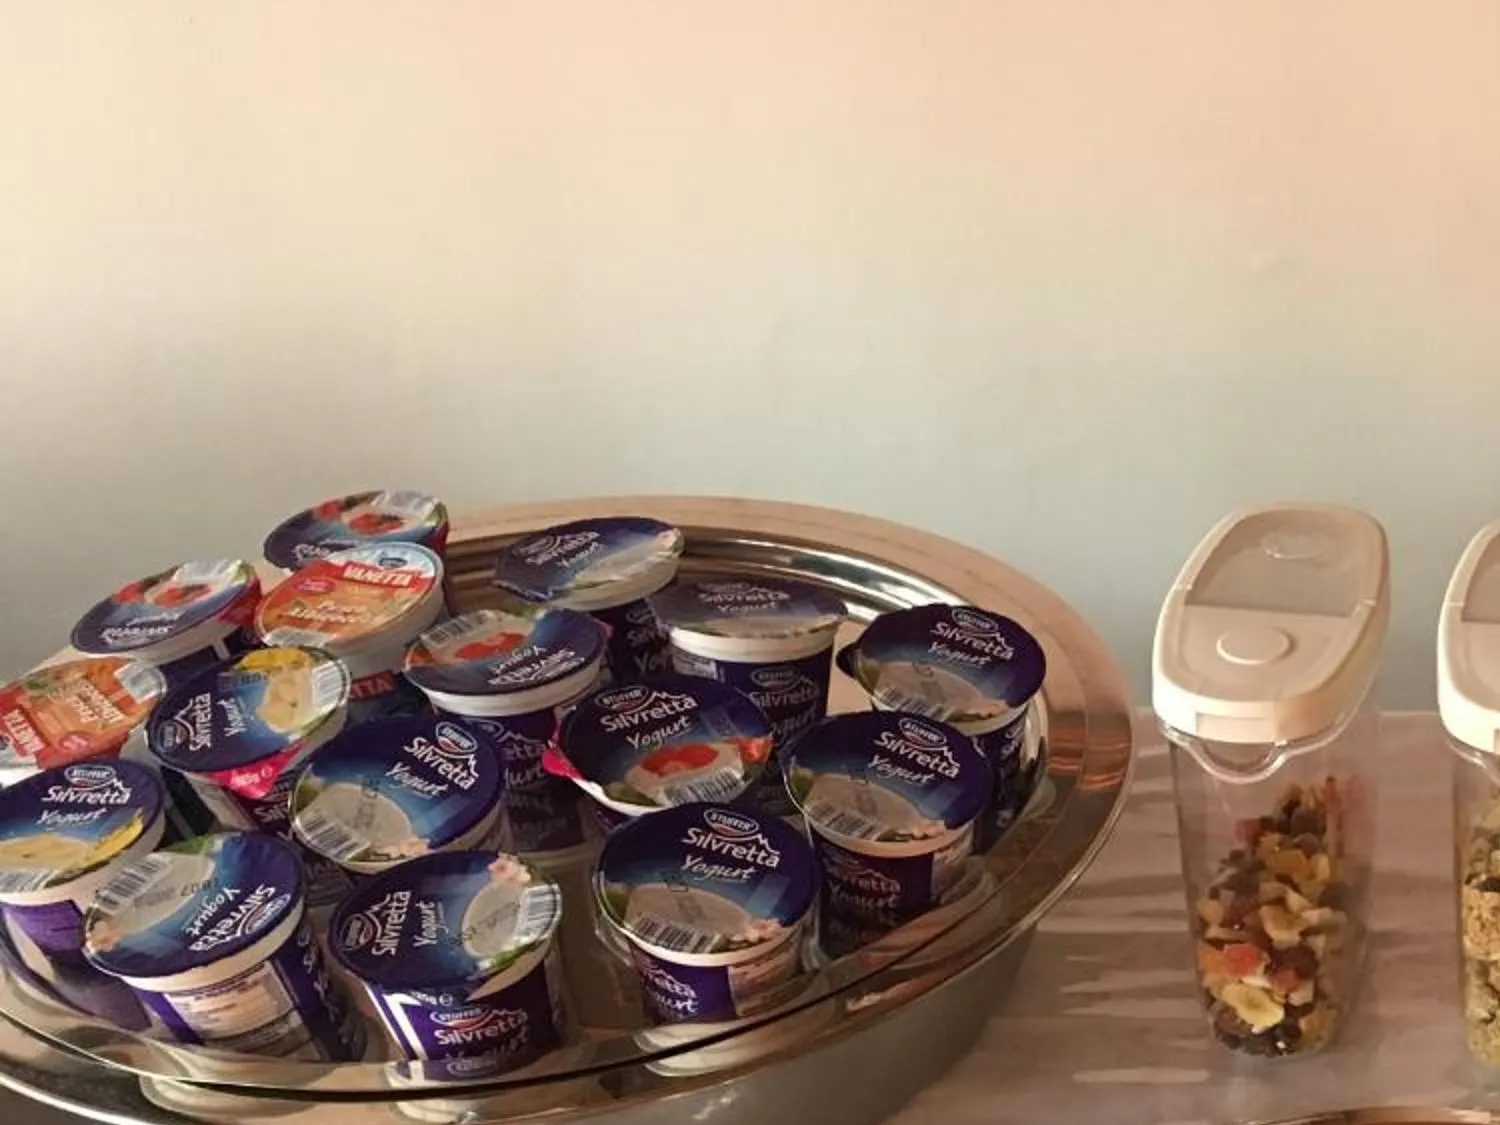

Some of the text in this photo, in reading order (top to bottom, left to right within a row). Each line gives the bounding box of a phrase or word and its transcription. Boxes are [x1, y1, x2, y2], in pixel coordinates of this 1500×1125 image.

[343, 564, 413, 587] VANETTA
[930, 621, 1014, 661] Silvretta
[189, 692, 212, 751] Silvretta
[600, 695, 698, 732] Silvretta
[626, 715, 692, 749] Yogurt
[404, 736, 476, 790] Silvretta
[867, 754, 936, 784] Yogurt
[873, 731, 961, 779] Silvretta
[40, 785, 132, 805] Silvretta
[385, 762, 449, 797] Yogurt
[680, 854, 754, 881] Yogurt
[681, 827, 781, 869] Silvretta
[184, 886, 241, 938] Yogurt
[188, 884, 276, 951] Silvretta
[372, 890, 411, 956] Silvretta
[413, 901, 438, 948] Yogurt
[434, 1009, 528, 1046] Silvretta
